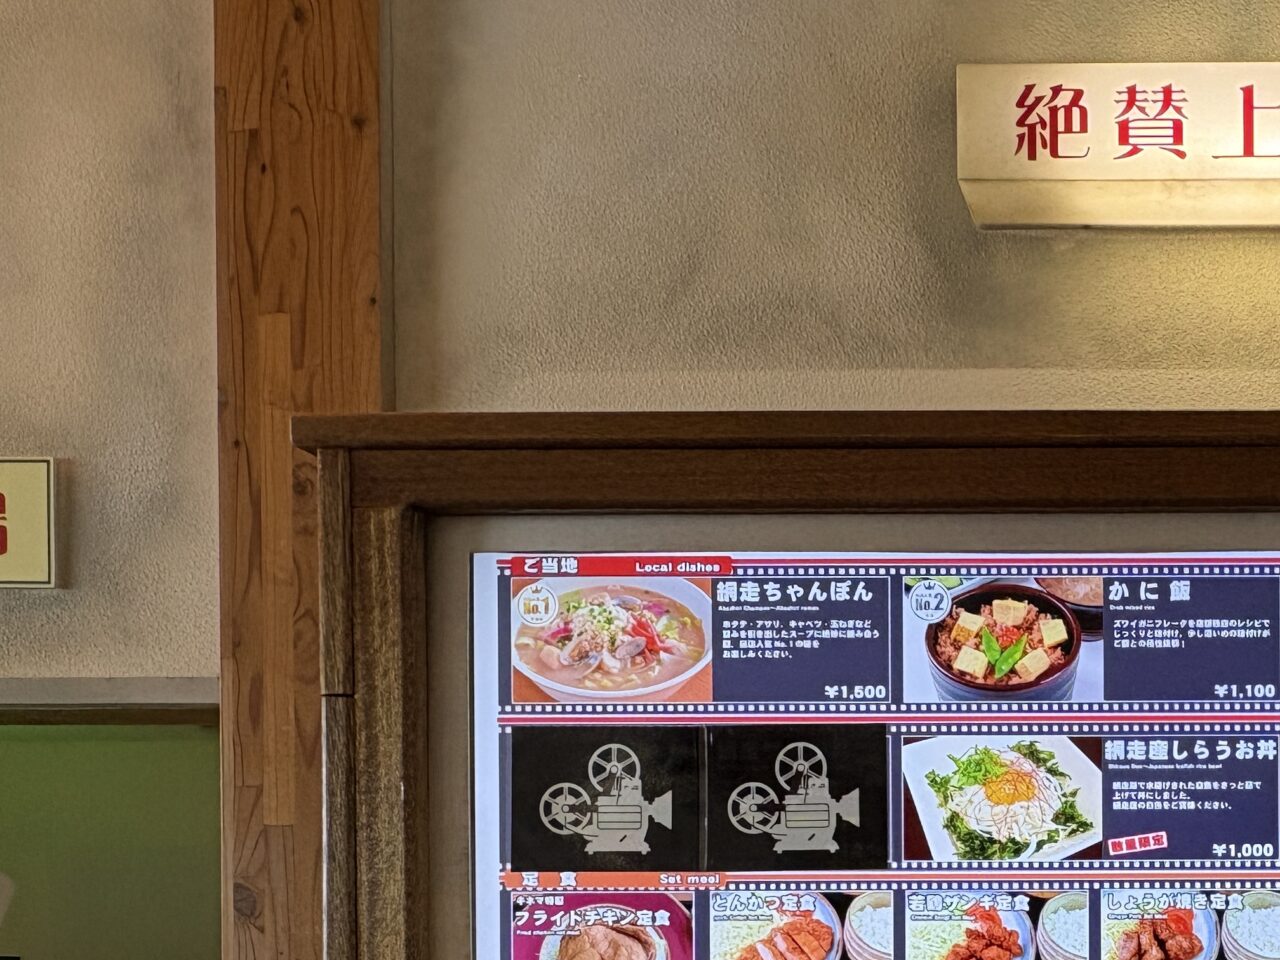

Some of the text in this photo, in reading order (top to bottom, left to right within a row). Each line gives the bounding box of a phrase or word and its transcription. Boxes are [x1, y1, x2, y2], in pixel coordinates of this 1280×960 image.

[524, 558, 578, 573] ご当地
[636, 562, 720, 573] Local dishes
[717, 581, 873, 602] 網走ちゃんぽん
[824, 685, 886, 699] ¥1,500
[1214, 684, 1276, 699] ¥1,100
[1104, 739, 1277, 761] 網走産しらうお丼
[1212, 843, 1274, 858] ¥1,000
[660, 874, 720, 885] Set meal
[713, 894, 817, 912] とんかつ定食
[1107, 893, 1245, 911] しょうが焼き定食
[515, 910, 671, 926] フライドチキン定食
